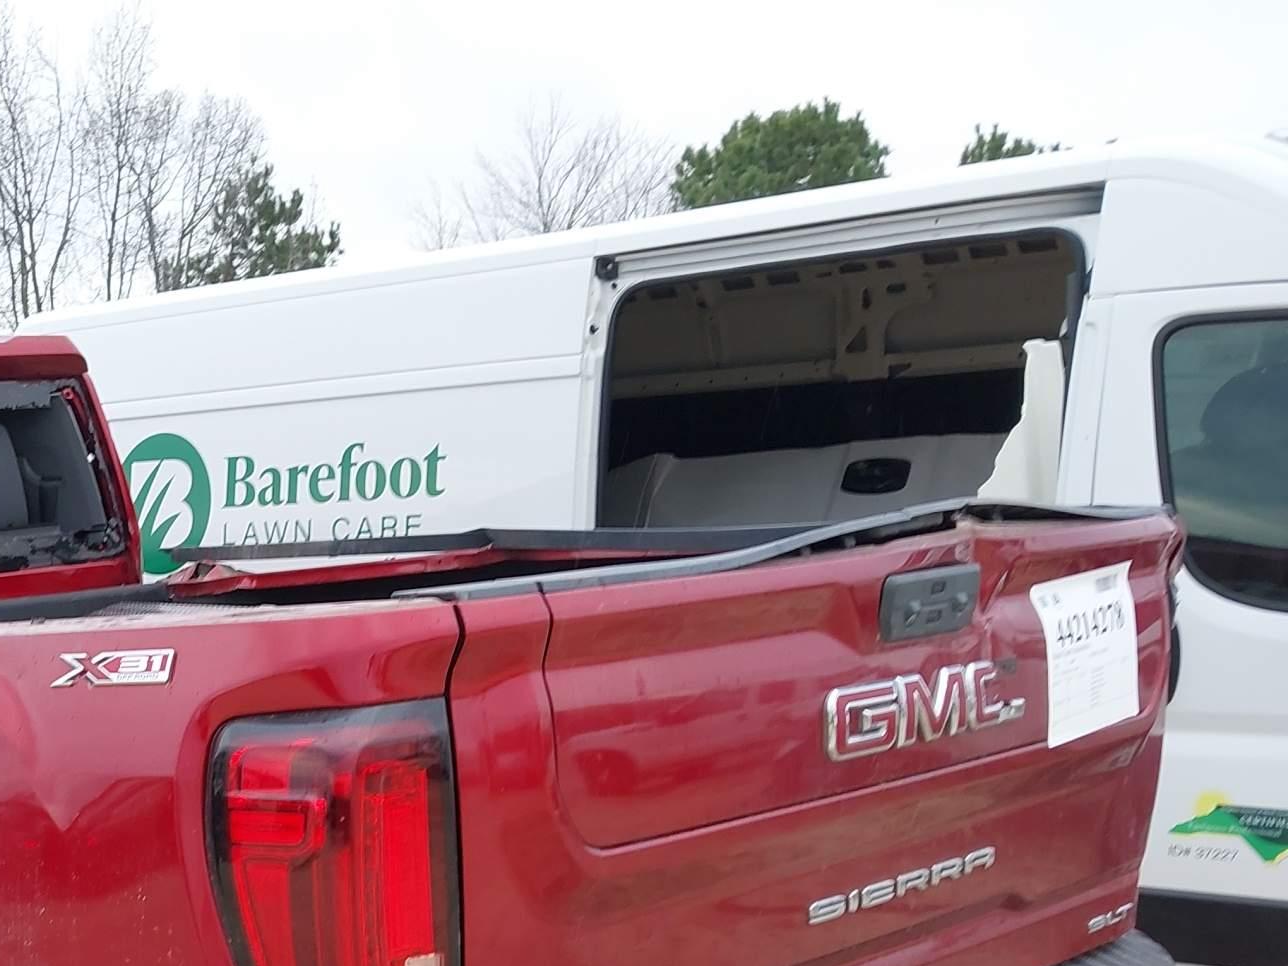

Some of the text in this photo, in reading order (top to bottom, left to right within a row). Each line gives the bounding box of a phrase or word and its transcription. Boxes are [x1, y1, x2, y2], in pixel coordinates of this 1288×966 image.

[221, 442, 447, 509] Barefoot
[221, 519, 312, 545] LAWN
[1057, 600, 1125, 648] 44214278
[825, 660, 1025, 762] GMC
[808, 846, 996, 925] SIERRA
[1088, 902, 1135, 934] SLT
